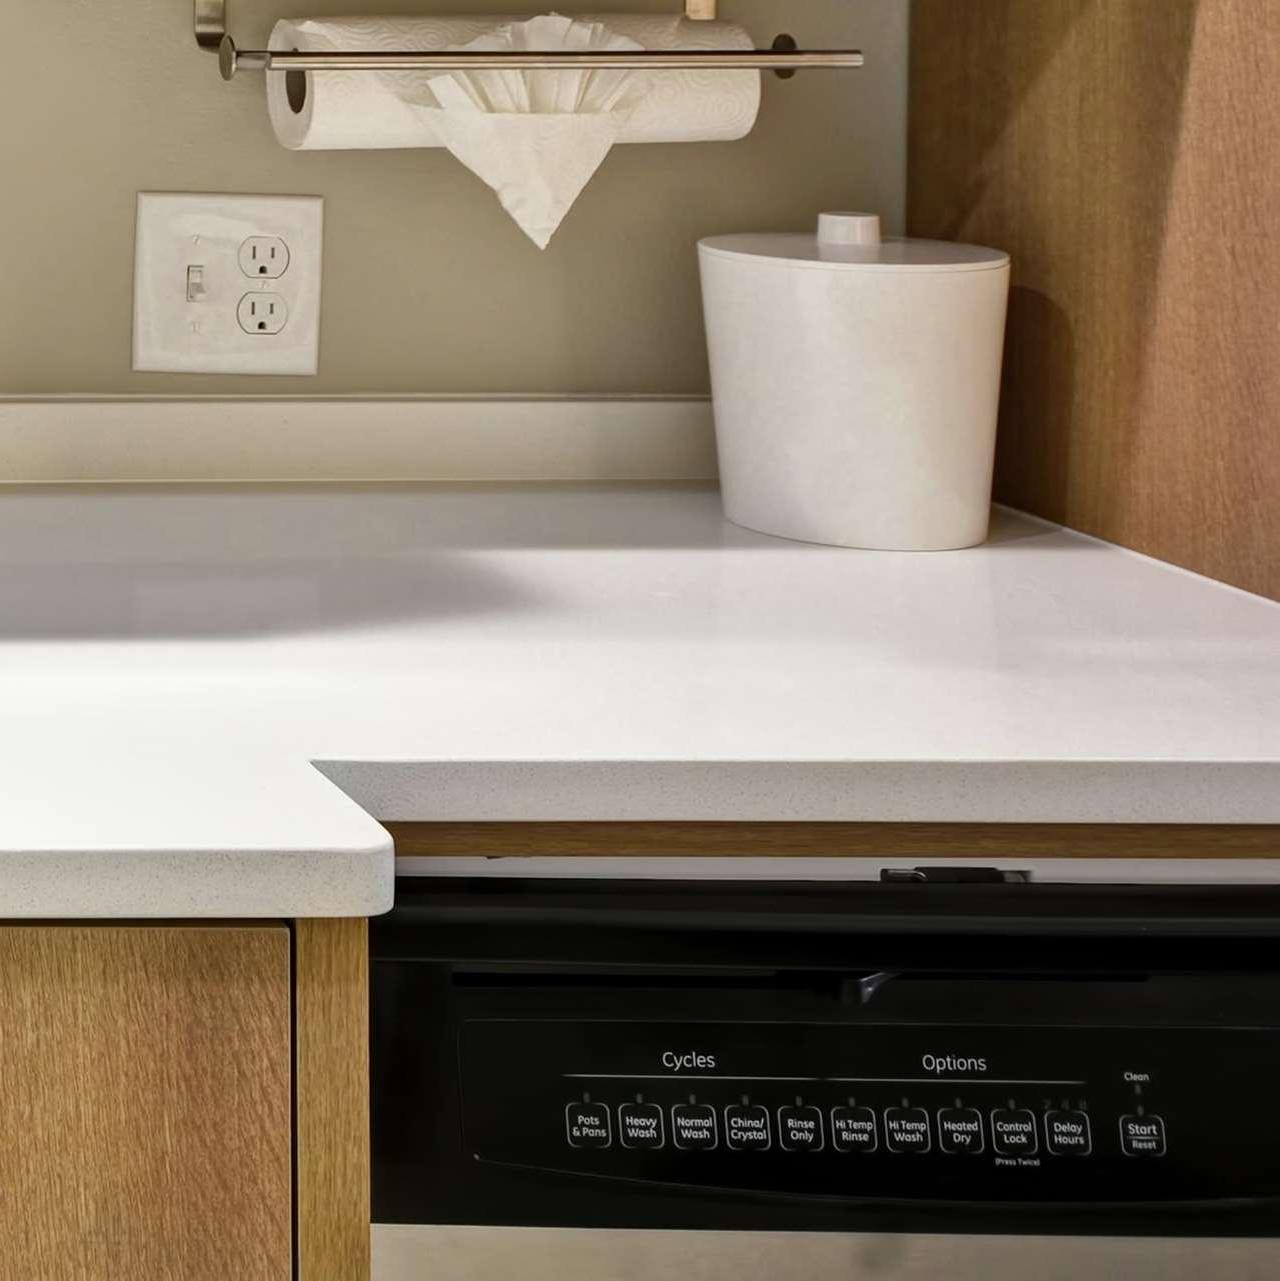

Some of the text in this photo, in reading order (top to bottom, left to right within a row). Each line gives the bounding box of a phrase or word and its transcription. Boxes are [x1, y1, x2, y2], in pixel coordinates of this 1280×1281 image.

[662, 1051, 716, 1071] Cycles
[922, 1054, 987, 1073] Options
[1124, 1072, 1149, 1081] Clean
[577, 1115, 600, 1125] Pots
[625, 1116, 657, 1128] Heavy
[677, 1117, 713, 1127] Normal
[730, 1117, 764, 1128] China/
[787, 1118, 815, 1129] Rinse
[835, 1120, 874, 1131] Hi Temp
[572, 1126, 607, 1137] & Pans
[889, 1120, 927, 1132] Hi Temp
[943, 1121, 978, 1132] Heated
[996, 1122, 1032, 1132] Control
[1053, 1122, 1083, 1135] Delay
[1128, 1123, 1158, 1136] Start
[627, 1128, 657, 1138] Wash
[681, 1128, 710, 1139] Wash
[730, 1129, 767, 1142] Crystal
[790, 1130, 814, 1143] Only
[841, 1131, 870, 1142] Rinse
[894, 1131, 923, 1142] Wash
[952, 1132, 972, 1145] Dry
[1003, 1133, 1027, 1144] Lock
[1054, 1134, 1085, 1145] Hours
